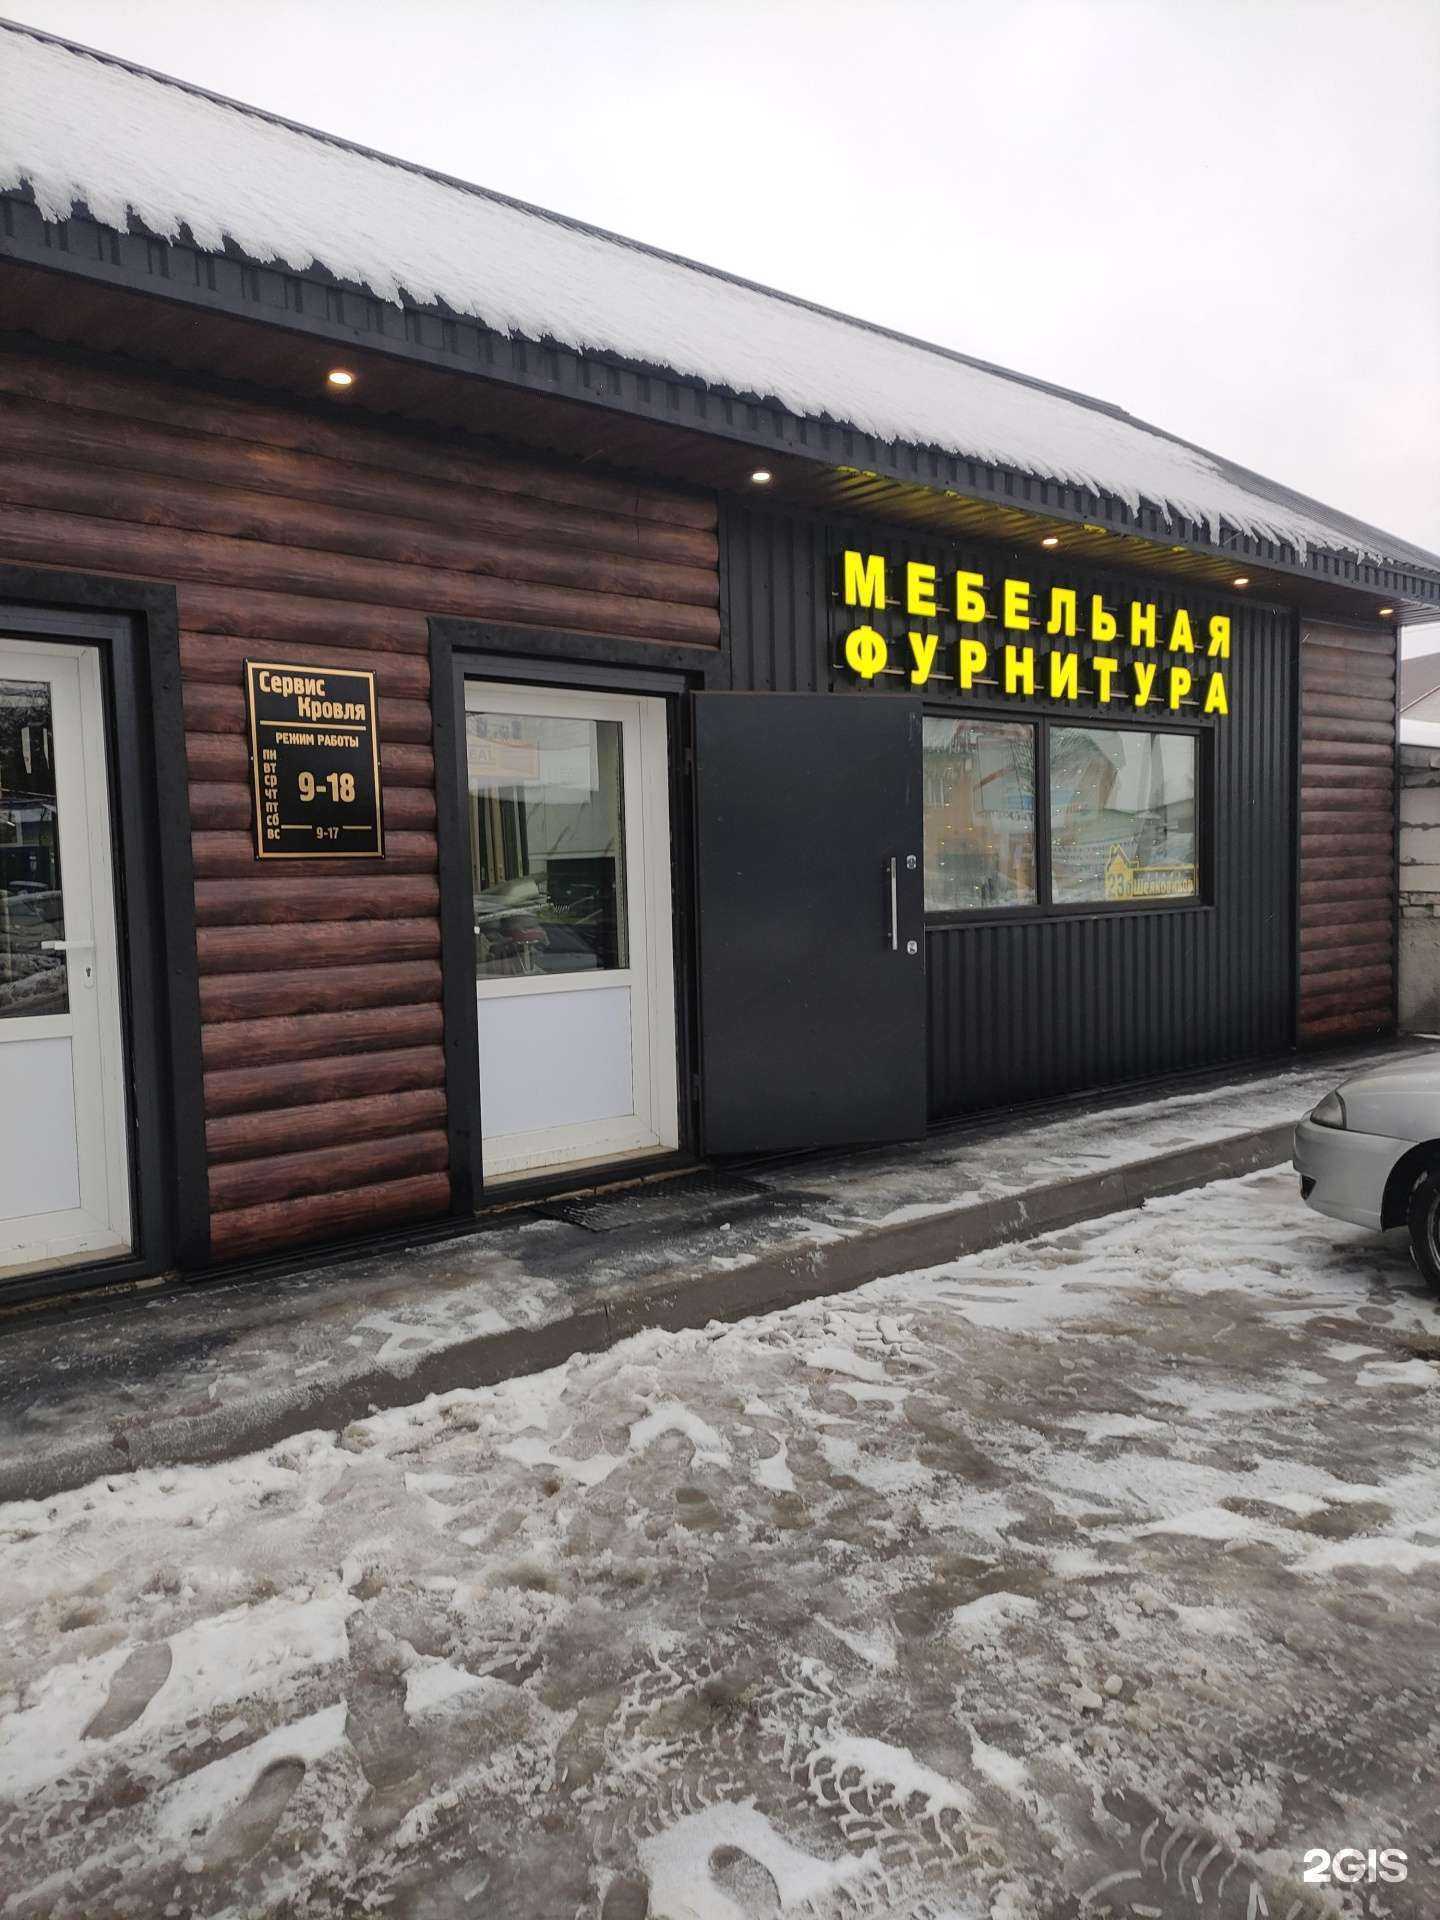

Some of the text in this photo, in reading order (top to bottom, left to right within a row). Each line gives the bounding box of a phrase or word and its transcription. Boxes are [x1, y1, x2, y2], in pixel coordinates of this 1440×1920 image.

[844, 550, 1231, 659] МЕБЕЛЬНАЯ
[845, 625, 1229, 715] ФУРНИТУРА
[259, 671, 326, 697] Сервис
[298, 696, 366, 721] Кровля
[275, 732, 359, 748] РЕЖИМ РАБОТЫ
[298, 771, 356, 803] 9-18
[316, 827, 340, 840] 9-17
